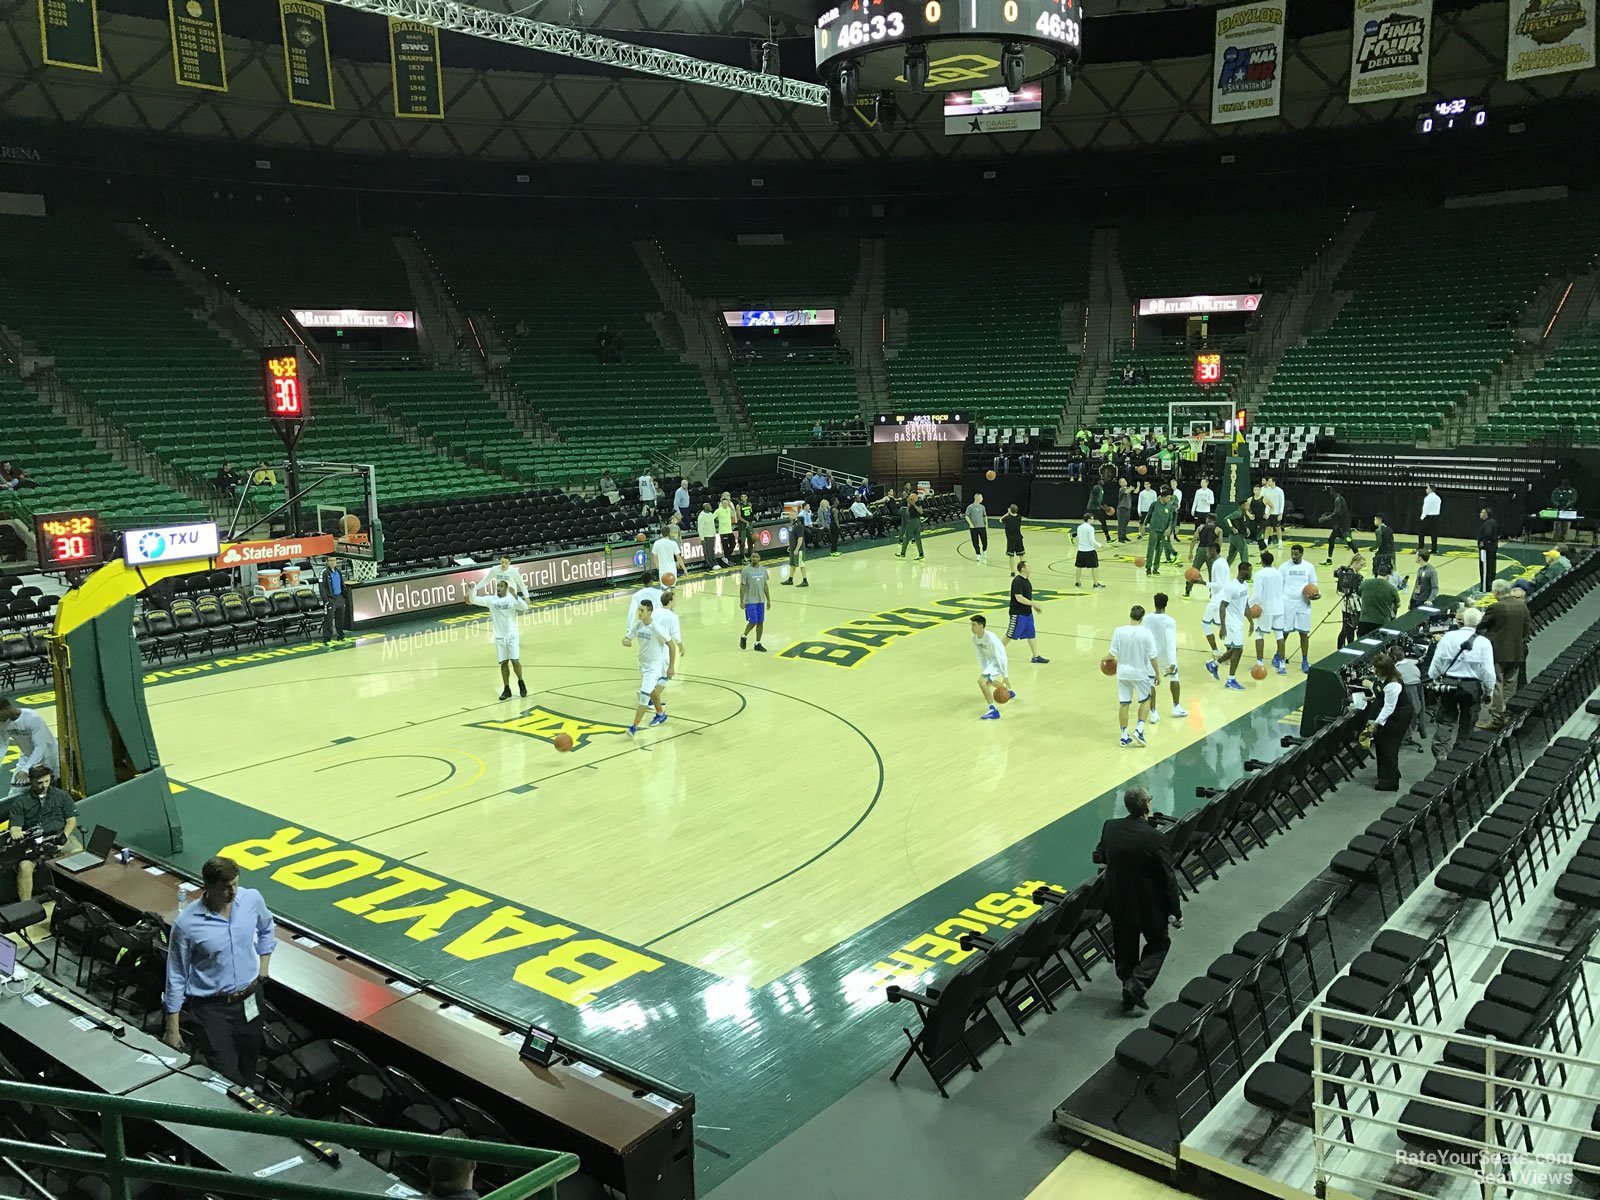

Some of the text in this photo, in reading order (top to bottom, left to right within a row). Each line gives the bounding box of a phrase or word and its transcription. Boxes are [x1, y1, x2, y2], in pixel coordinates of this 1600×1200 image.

[284, 4, 322, 21] BAYLOR
[927, 1, 941, 22] 0
[1004, 1, 1018, 21] 0
[393, 23, 435, 36] BAYLOR
[838, 12, 905, 48] 46:33
[1036, 11, 1081, 46] 46:33
[1218, 8, 1282, 36] BAYLOR
[1377, 21, 1424, 40] FINAL
[401, 43, 429, 51] SWC
[1360, 35, 1424, 62] FOUR
[1368, 54, 1414, 69] DENVER
[1512, 53, 1589, 73] CHAMPIONS
[1219, 98, 1273, 113] FINAL FOUR
[1435, 98, 1466, 115] 46:32
[1423, 118, 1432, 132] 0
[1448, 119, 1454, 128] 1
[1475, 111, 1486, 126] 0
[0, 146, 40, 161] RENA
[268, 357, 297, 376] 46:32
[1201, 364, 1217, 379] 30
[275, 379, 297, 411] 30
[895, 432, 947, 441] BASKETBALL
[906, 425, 937, 433] BAYLOR
[44, 517, 92, 535] 46:32
[169, 530, 198, 546] TXU
[58, 537, 84, 559] 30
[377, 584, 456, 613] Welcome
[521, 561, 557, 588] errell
[561, 558, 606, 582] Center
[775, 588, 1092, 670] BAYLOR
[217, 827, 666, 1007] BAYLOR
